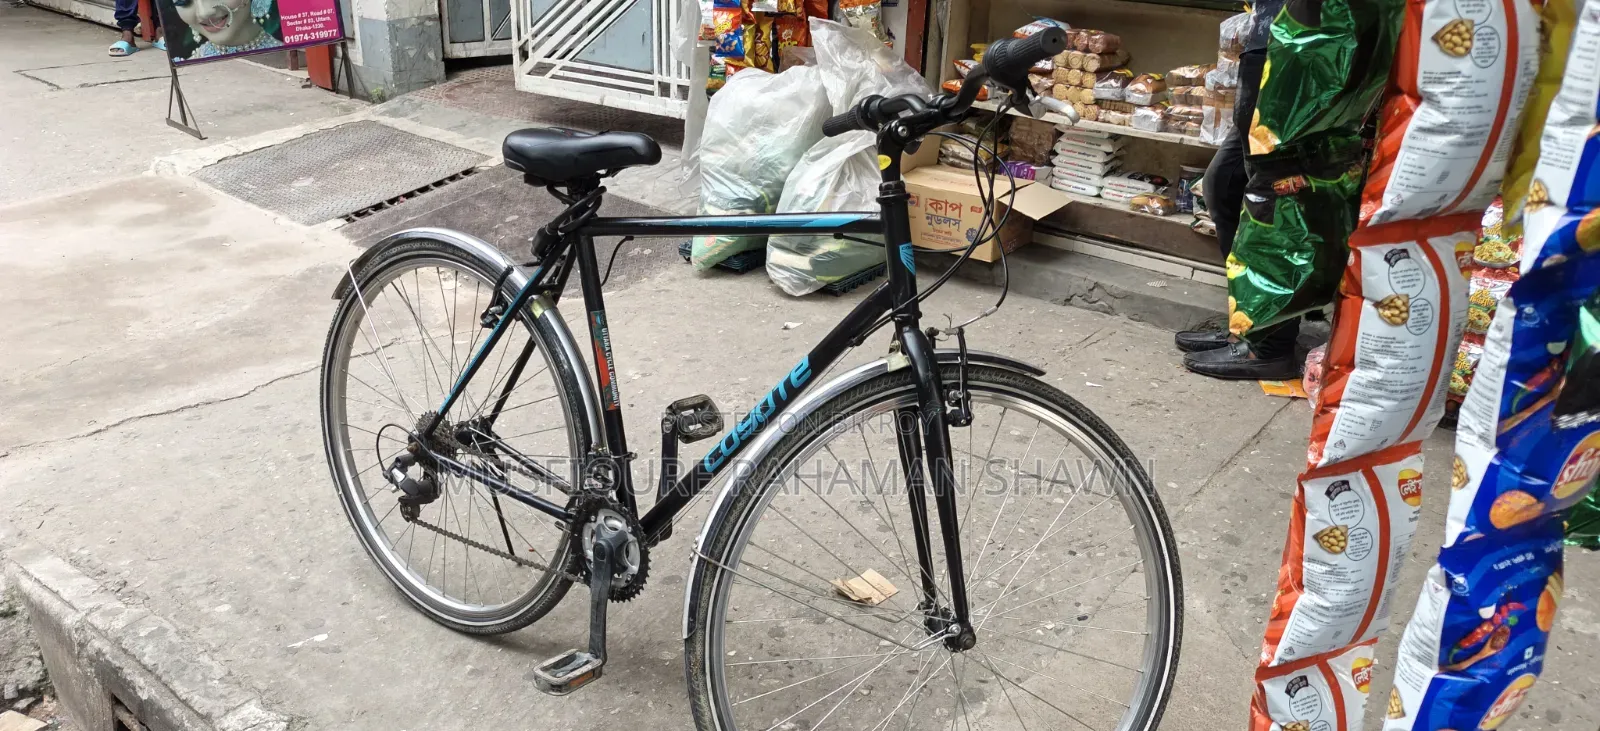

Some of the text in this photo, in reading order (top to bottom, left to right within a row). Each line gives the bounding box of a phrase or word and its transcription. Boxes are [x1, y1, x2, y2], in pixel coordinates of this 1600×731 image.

[284, 29, 337, 43] 01974-319977
[928, 198, 963, 218] কাপ
[609, 371, 620, 407] COMMUNITY
